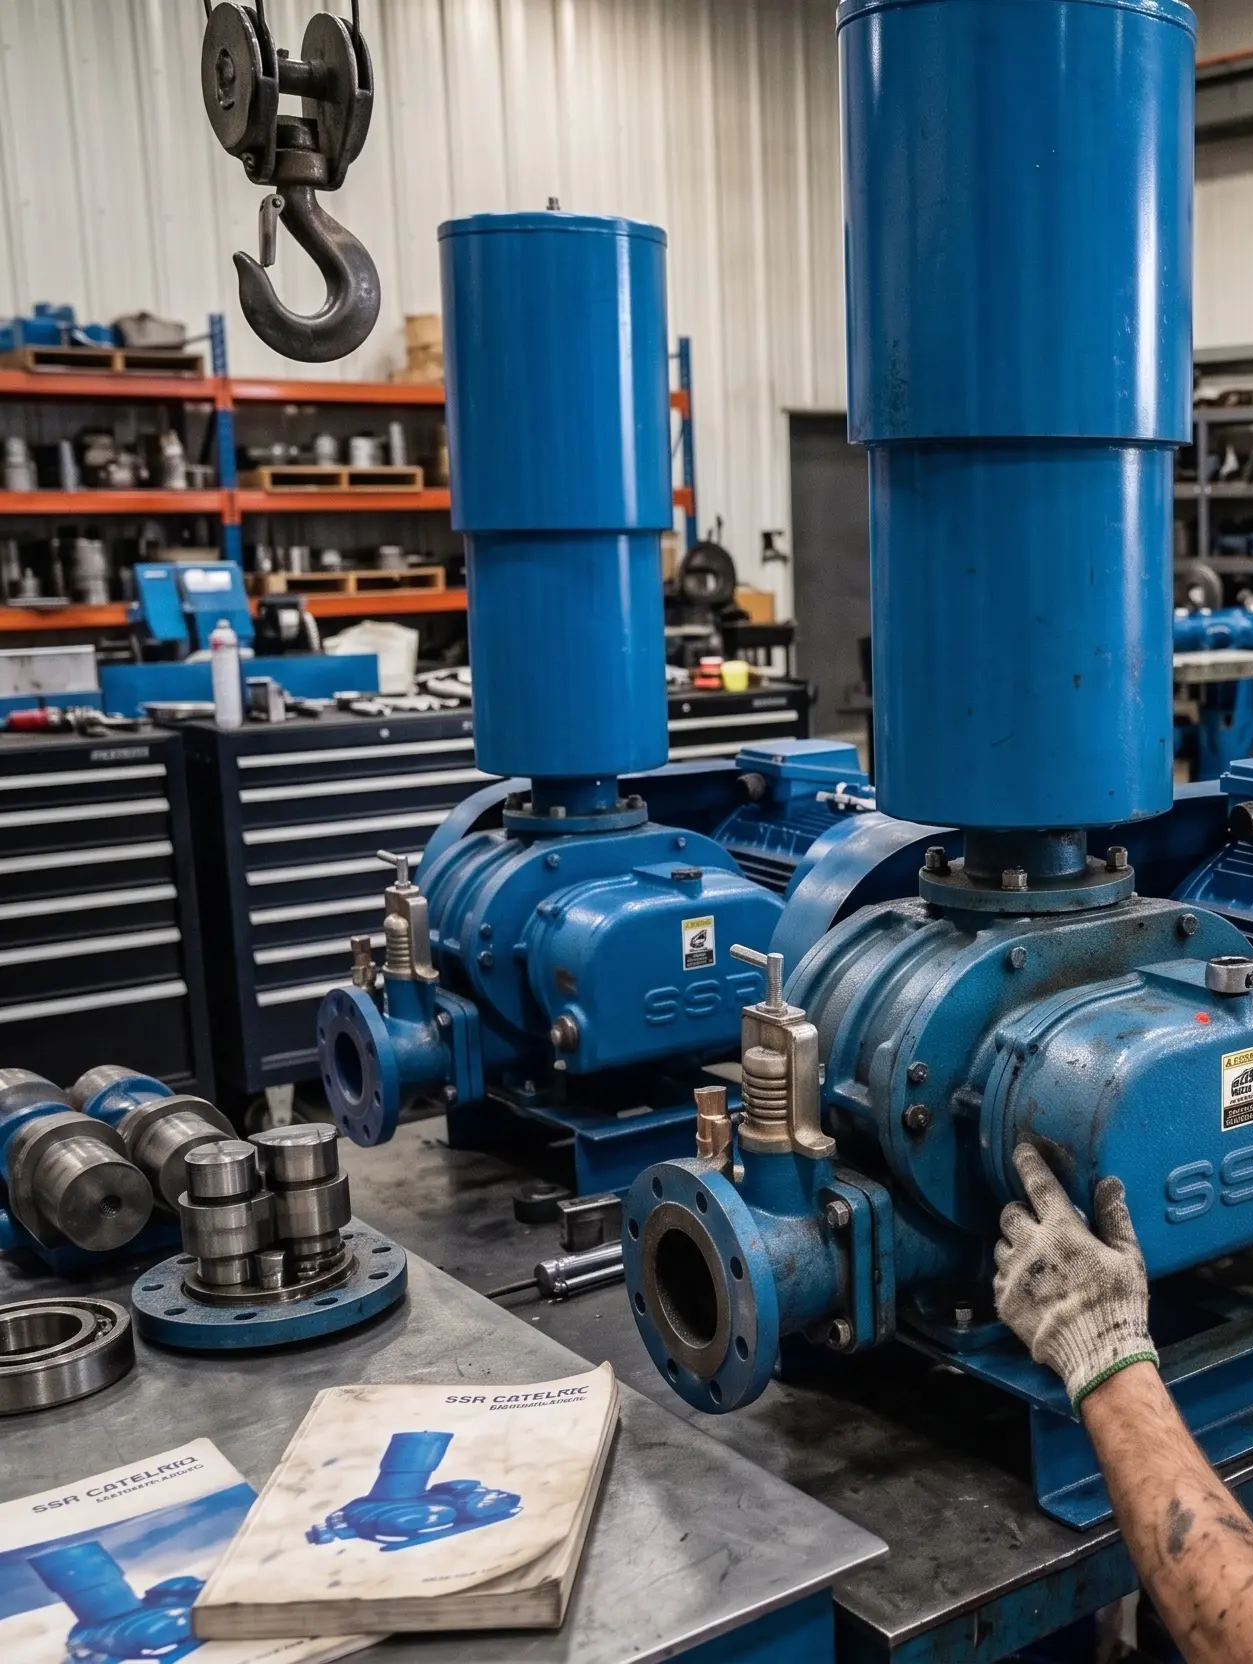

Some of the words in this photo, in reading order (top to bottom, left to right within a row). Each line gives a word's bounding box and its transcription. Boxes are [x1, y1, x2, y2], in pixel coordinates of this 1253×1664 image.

[644, 970, 766, 1027] SSR
[445, 1395, 487, 1404] SSR
[32, 1495, 81, 1514] SSR
